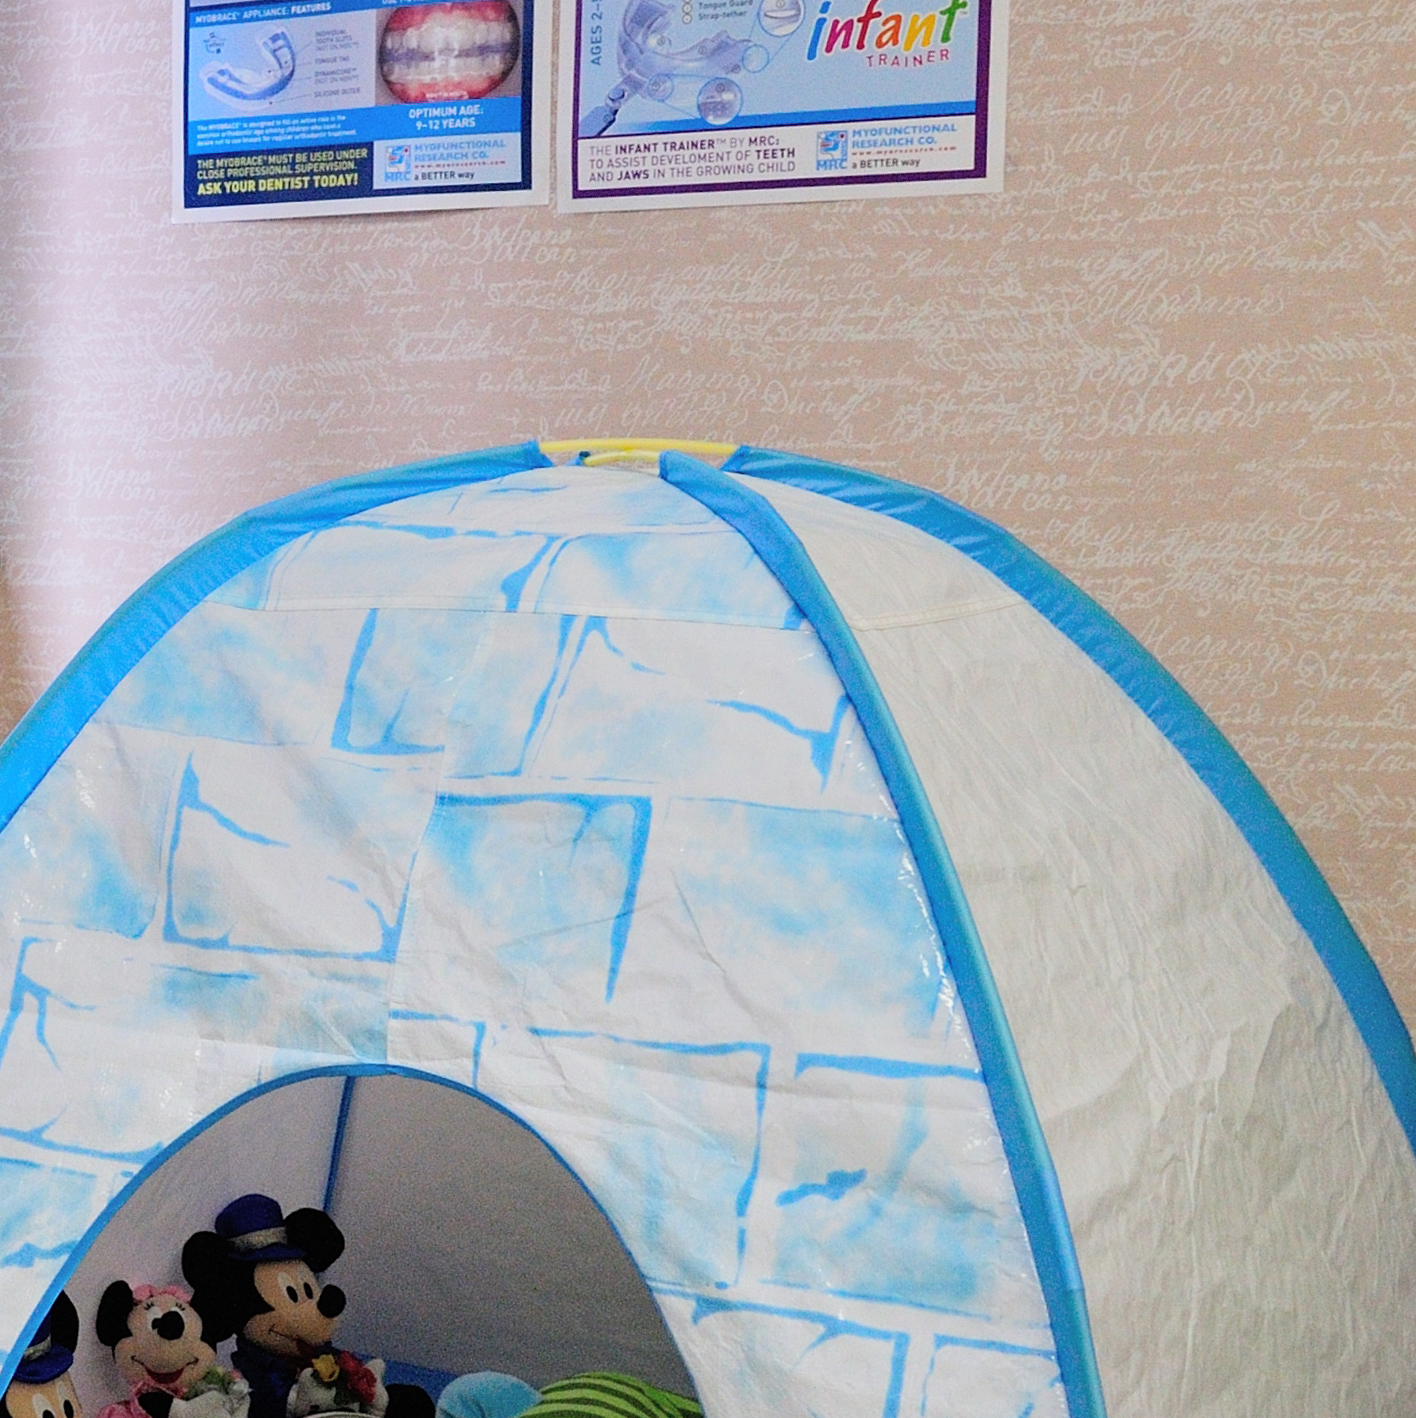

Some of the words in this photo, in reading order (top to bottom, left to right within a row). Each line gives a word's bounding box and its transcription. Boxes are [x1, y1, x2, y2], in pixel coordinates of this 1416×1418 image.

[291, 3, 331, 15] FEATURES
[699, 1, 727, 11] Tongue
[729, 0, 753, 7] Guard
[591, 25, 603, 66] AGES
[866, 49, 950, 67] TRAINER
[409, 107, 457, 119] OPTIMUM
[459, 105, 484, 115] AGE:
[442, 117, 476, 129] YEARS
[852, 123, 957, 138] MYOFUNCTIONAL
[414, 140, 505, 152] MYOFUNCTIONAL
[589, 146, 611, 156] THE
[615, 143, 658, 155] INFANT
[729, 138, 745, 148] BY
[748, 136, 780, 147] MRC:
[852, 137, 914, 149] RESEARCH
[918, 135, 937, 145] CO.
[197, 159, 214, 169] THE
[268, 153, 293, 164] MUST
[296, 153, 308, 162] BE
[310, 151, 333, 162] USED
[336, 148, 367, 159] UNDER
[414, 151, 469, 162] RESEARCH
[471, 151, 489, 159] CO.
[590, 159, 603, 169] TO
[607, 157, 646, 168] ASSIST
[651, 151, 731, 166] DEVELOMENT
[735, 151, 751, 161] OF
[756, 148, 795, 160] TEETH
[197, 170, 225, 179] CLOSE
[227, 165, 292, 178] PROFESSIONAL
[294, 162, 357, 173] SUPERVISION.
[816, 159, 847, 171] MRC
[860, 159, 898, 169] BETTER
[901, 159, 920, 167] way
[384, 172, 411, 182] MRC
[422, 171, 455, 180] BETTER
[458, 172, 475, 180] way
[589, 172, 614, 182] AND
[617, 170, 649, 181] JAWS
[654, 169, 665, 179] IN
[670, 167, 692, 178] THE
[696, 164, 754, 177] GROWING
[758, 161, 795, 173] CHILD
[197, 183, 222, 195] ASK
[224, 180, 256, 193] YOUR
[259, 176, 309, 192] DENTIST
[314, 173, 358, 187] TODAY!
